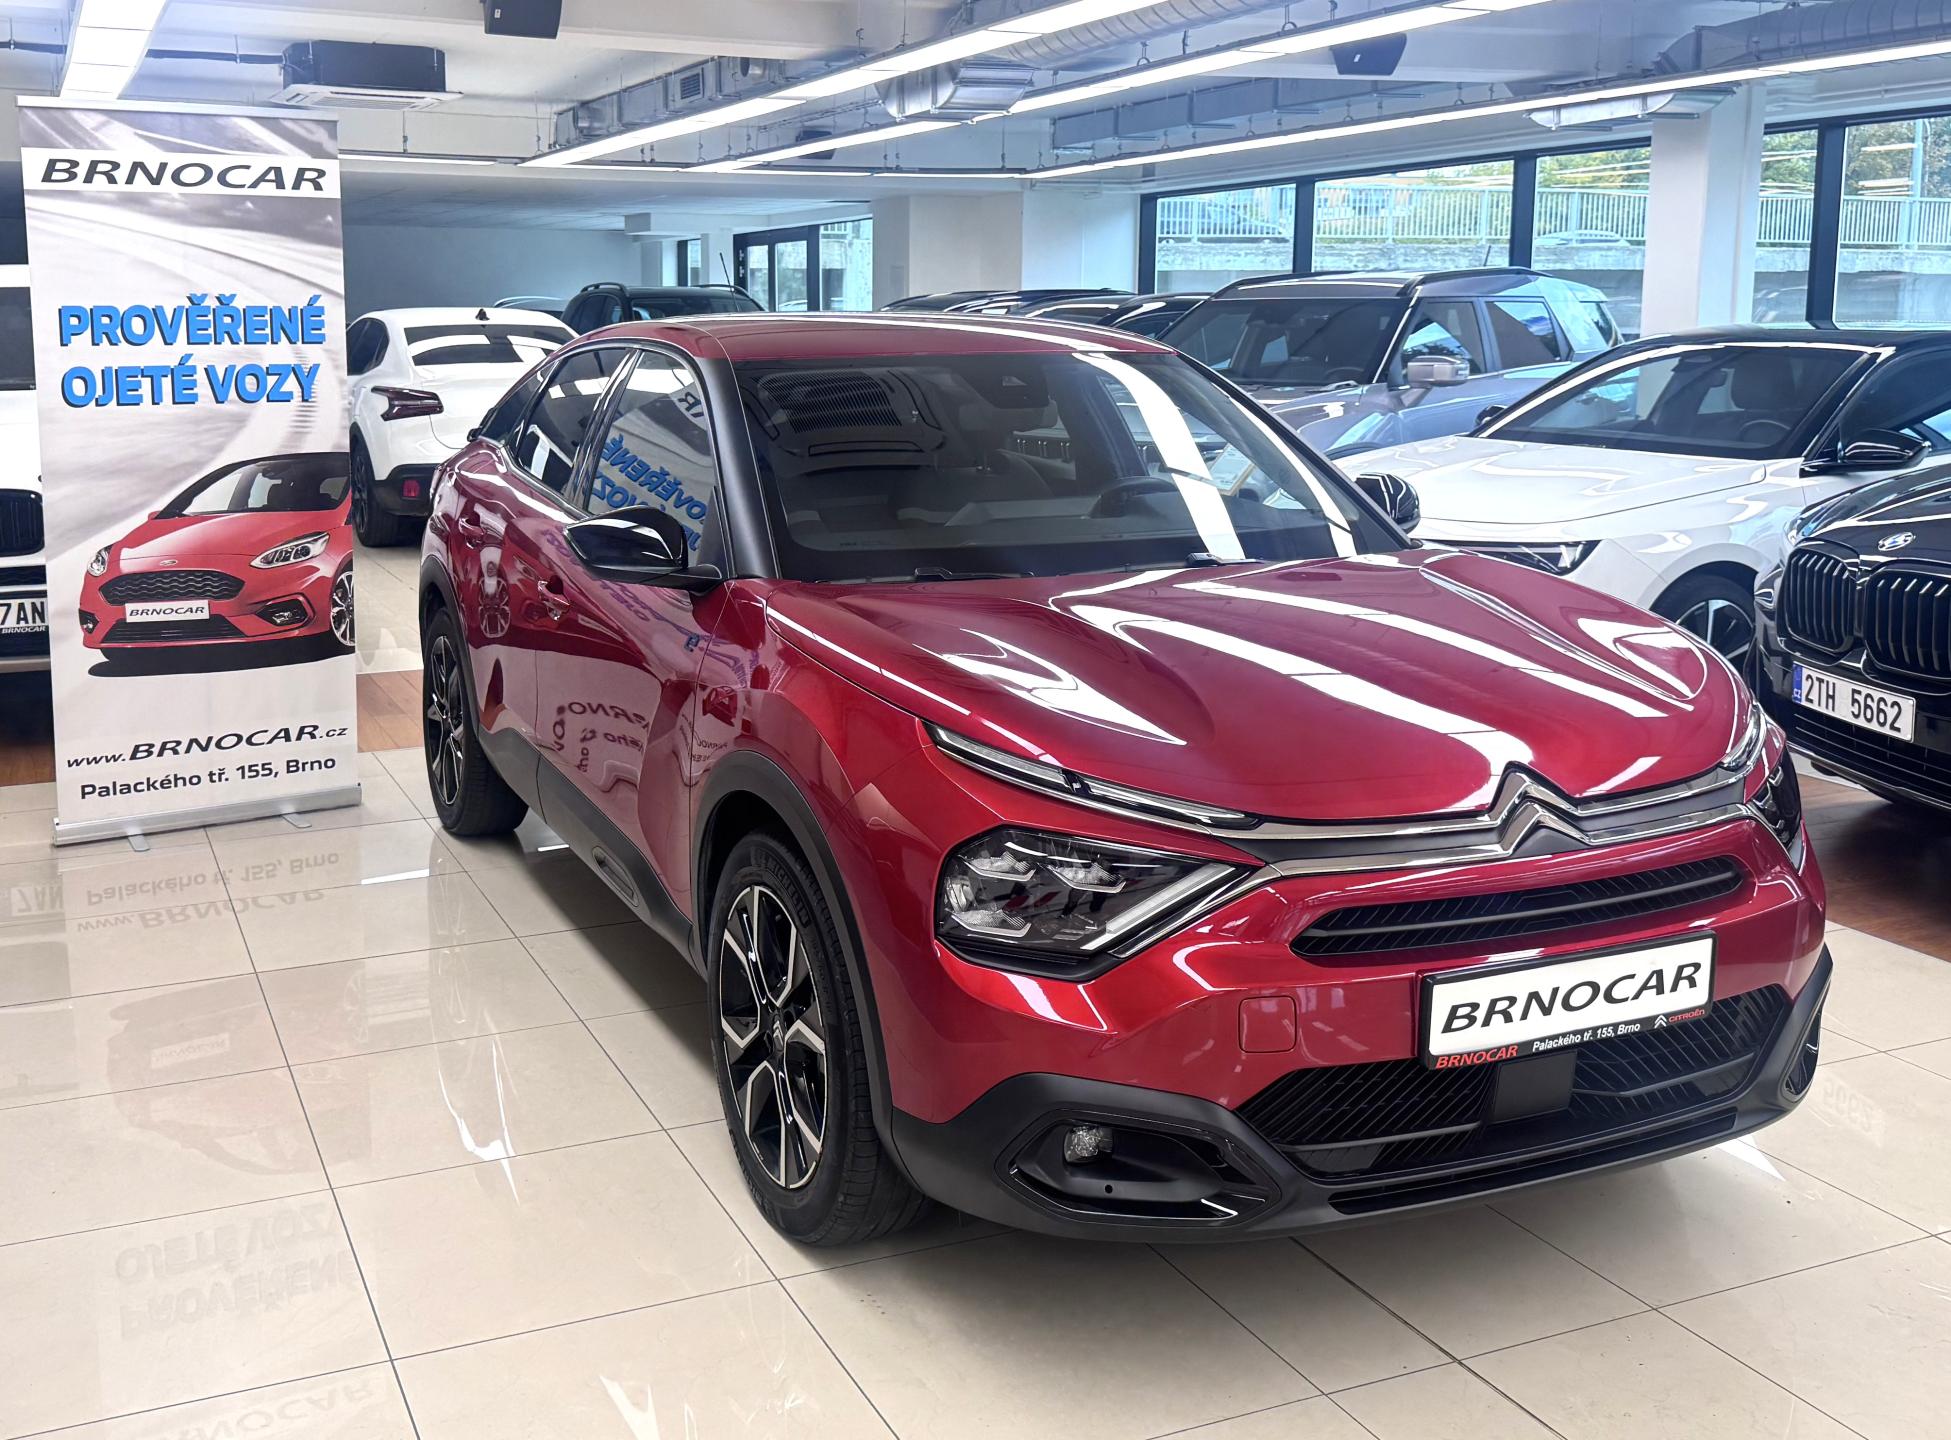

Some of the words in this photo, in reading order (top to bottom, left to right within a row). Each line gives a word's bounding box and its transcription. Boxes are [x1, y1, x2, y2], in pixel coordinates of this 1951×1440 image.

[41, 158, 327, 191] BRNOCAR
[58, 294, 326, 346] PROVĚŘENÉ
[61, 353, 199, 408] OJETÉ
[205, 364, 321, 404] VOZY
[1, 626, 46, 634] BRNOCAR
[128, 605, 206, 618] BRNOCAR
[1805, 673, 1837, 713] 2TH
[1851, 688, 1902, 733] 5662
[67, 724, 348, 768] www.BRNOCAR.cz
[80, 773, 202, 799] Palackého
[208, 768, 229, 785] tř.
[236, 762, 280, 780] 155,
[286, 757, 336, 774] Brno
[1441, 962, 1702, 1034] BRNOCAR
[1435, 1045, 1518, 1069] BRNOCAR
[1532, 1029, 1582, 1053] Palackého
[1597, 1026, 1615, 1041] 155,
[1617, 1022, 1641, 1036] Brno
